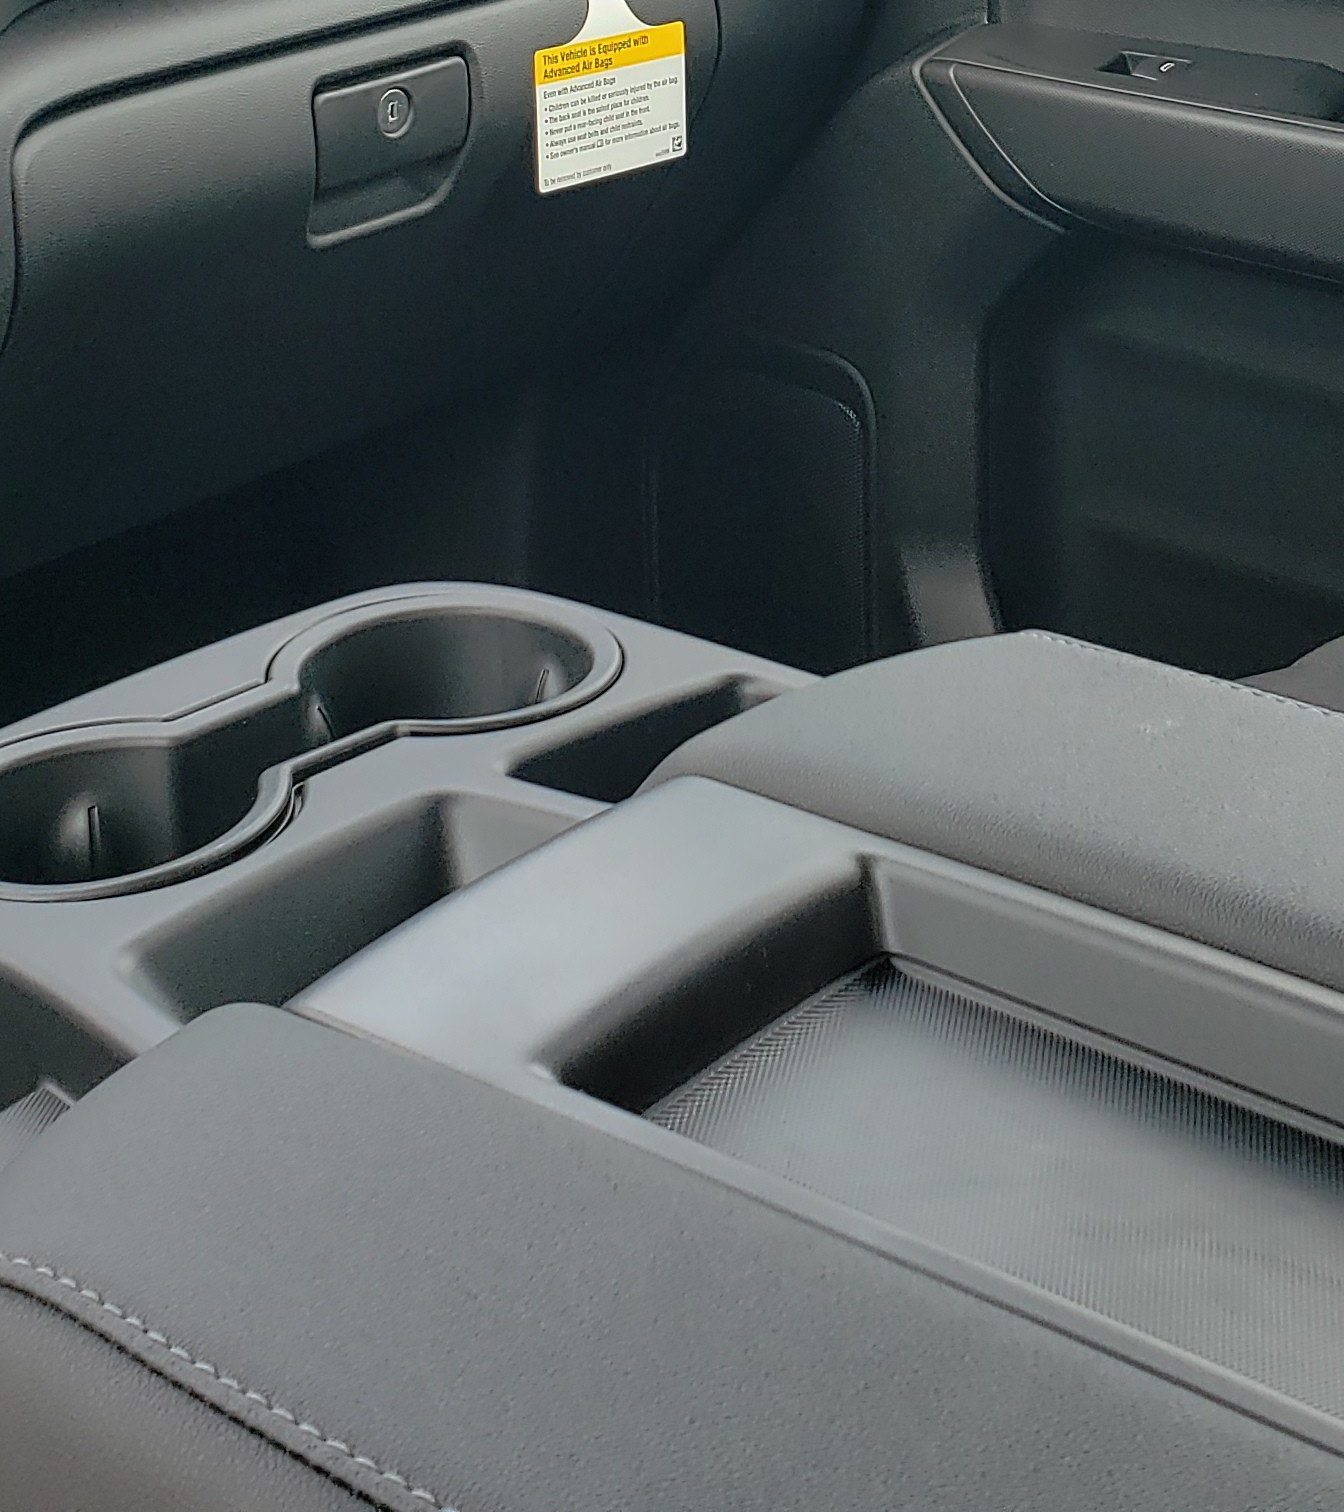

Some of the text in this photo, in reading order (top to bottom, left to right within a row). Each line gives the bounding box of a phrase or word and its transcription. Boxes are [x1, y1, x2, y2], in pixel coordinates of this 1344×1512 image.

[542, 54, 558, 66] This
[560, 48, 588, 61] Vehicle
[598, 37, 631, 54] Equipped
[633, 34, 649, 47] with
[543, 56, 613, 80] Advanced Air Bags
